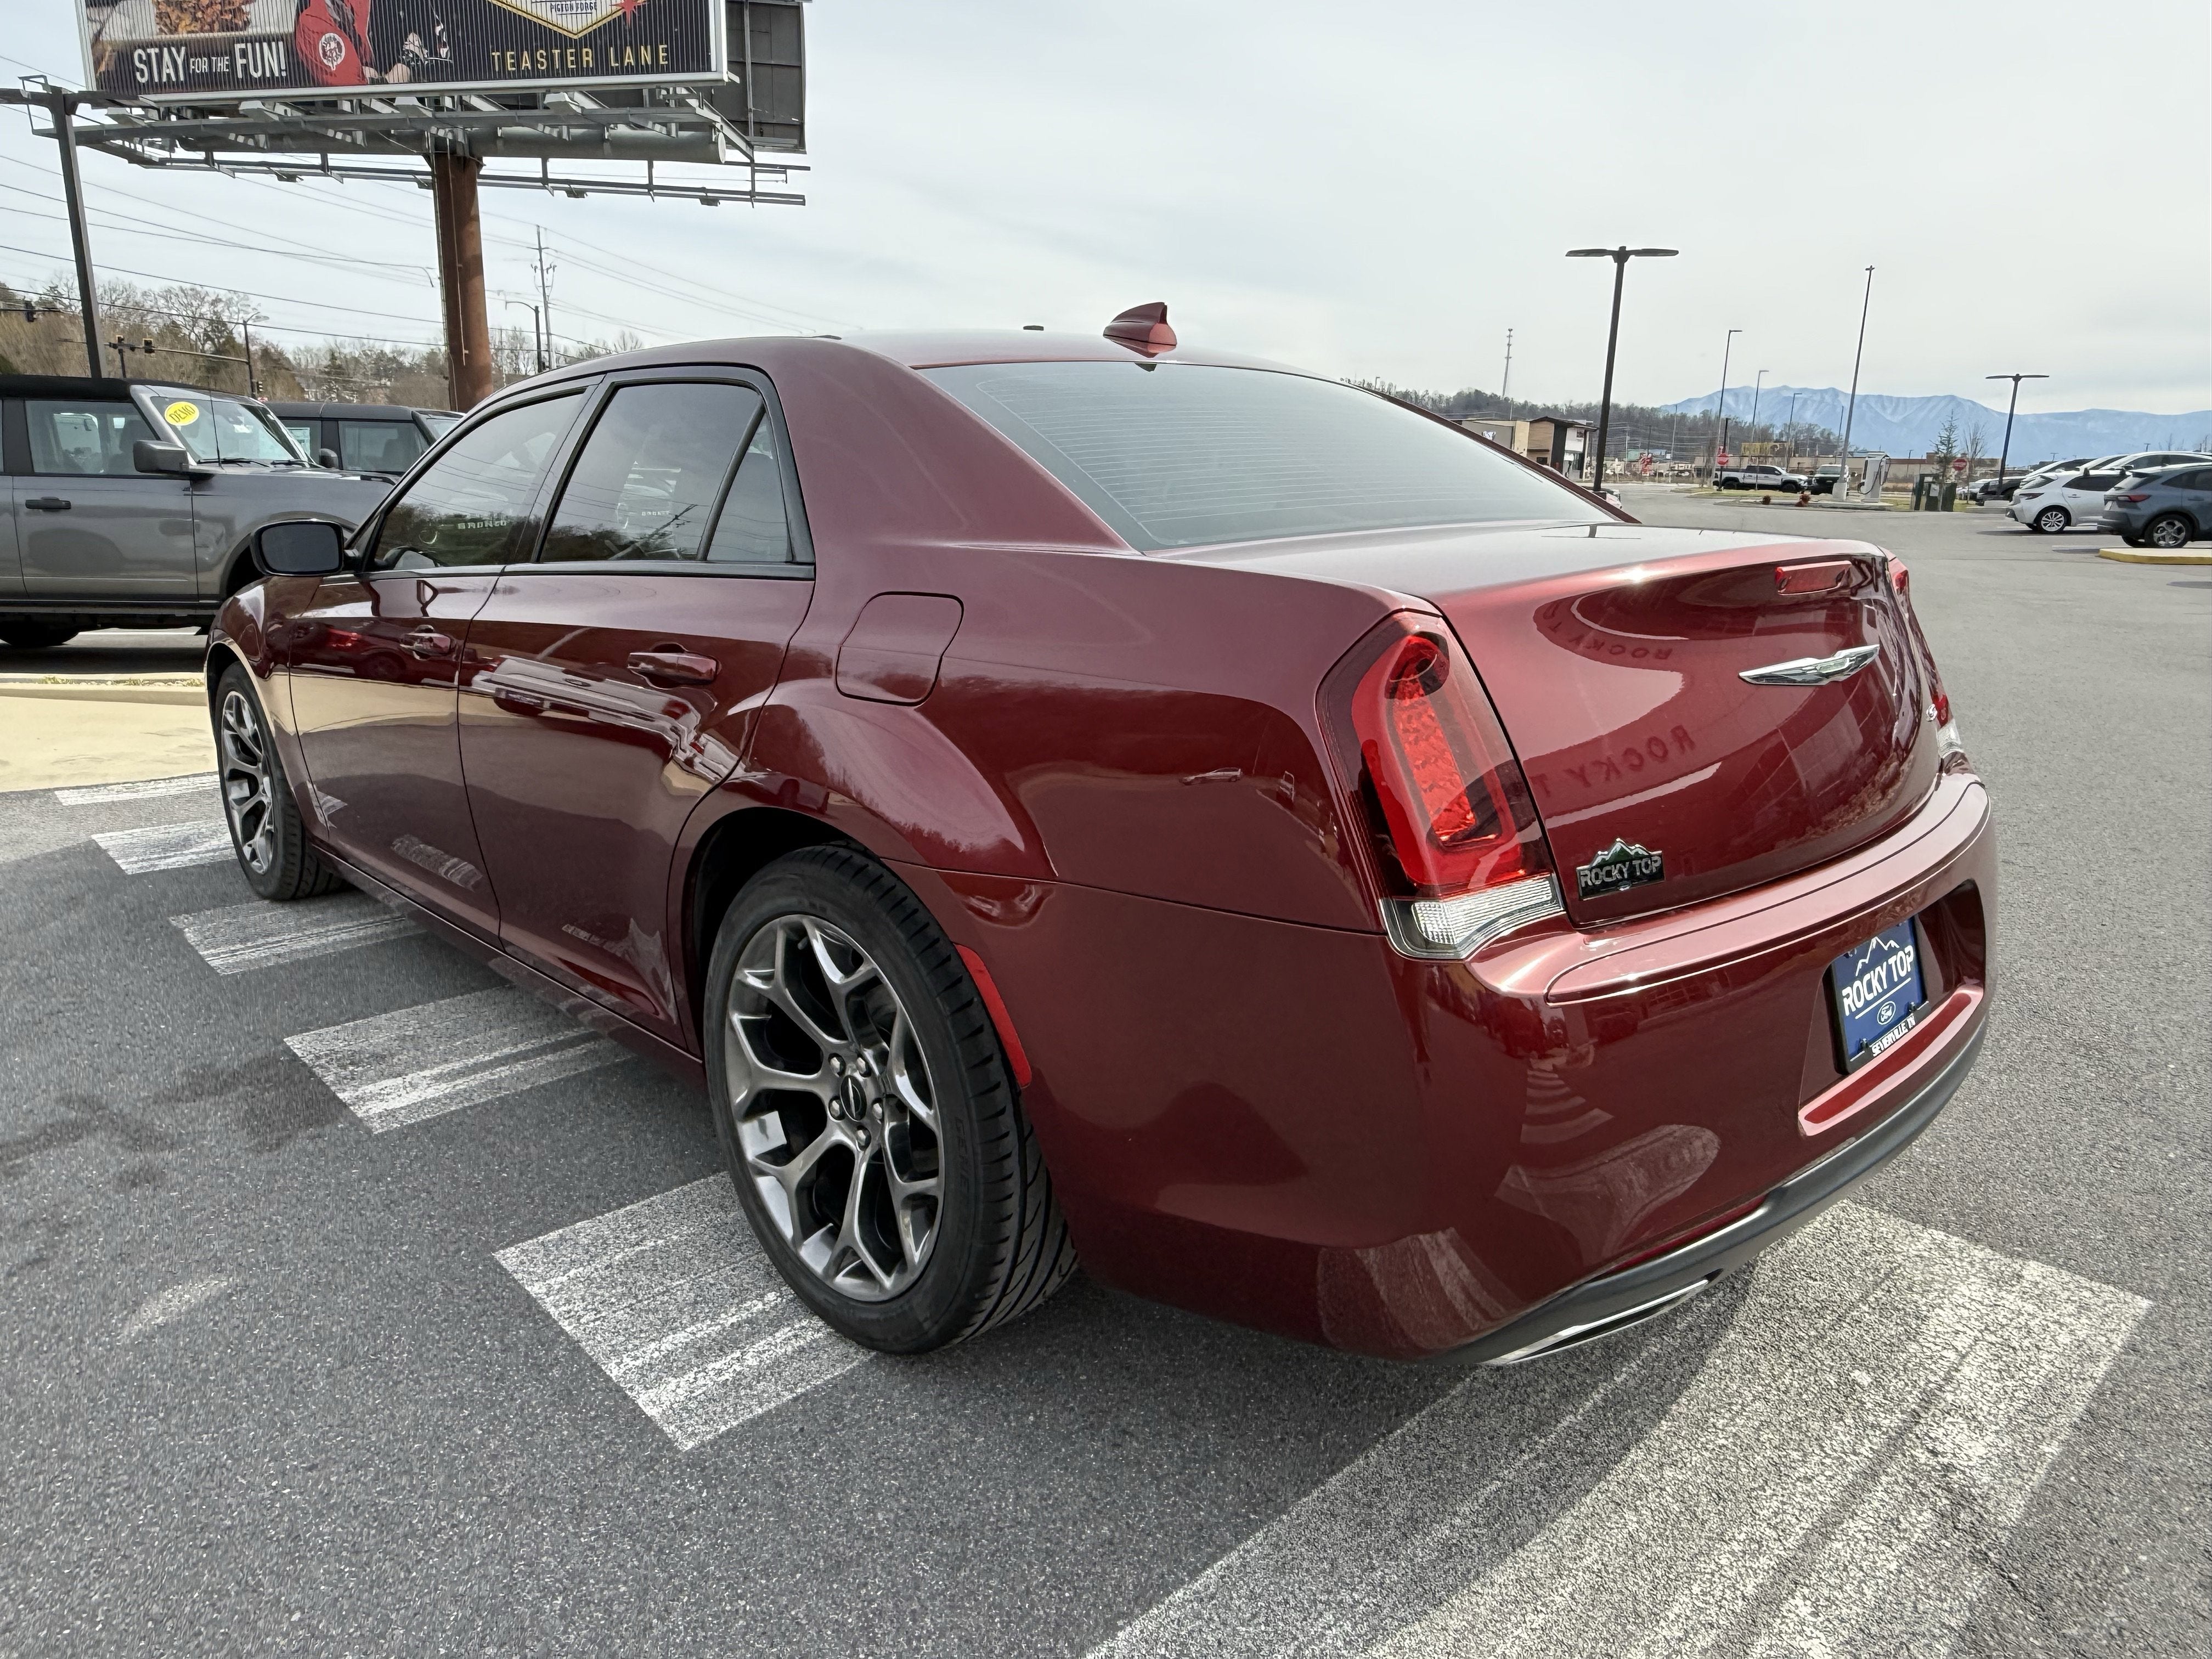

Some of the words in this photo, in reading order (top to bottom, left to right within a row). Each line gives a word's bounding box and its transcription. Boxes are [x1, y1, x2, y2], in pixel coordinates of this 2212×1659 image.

[134, 46, 186, 84] STAY
[190, 58, 207, 74] FOR
[212, 57, 229, 73] THE
[234, 41, 286, 80] FUN!
[492, 48, 593, 71] TEASTER
[610, 44, 668, 67] LANE
[168, 405, 195, 423] DEMO
[1580, 861, 1629, 887] ROCKY
[1633, 855, 1662, 876] TOP
[1842, 962, 1888, 1016] ROCKY
[1888, 945, 1915, 981] TOP
